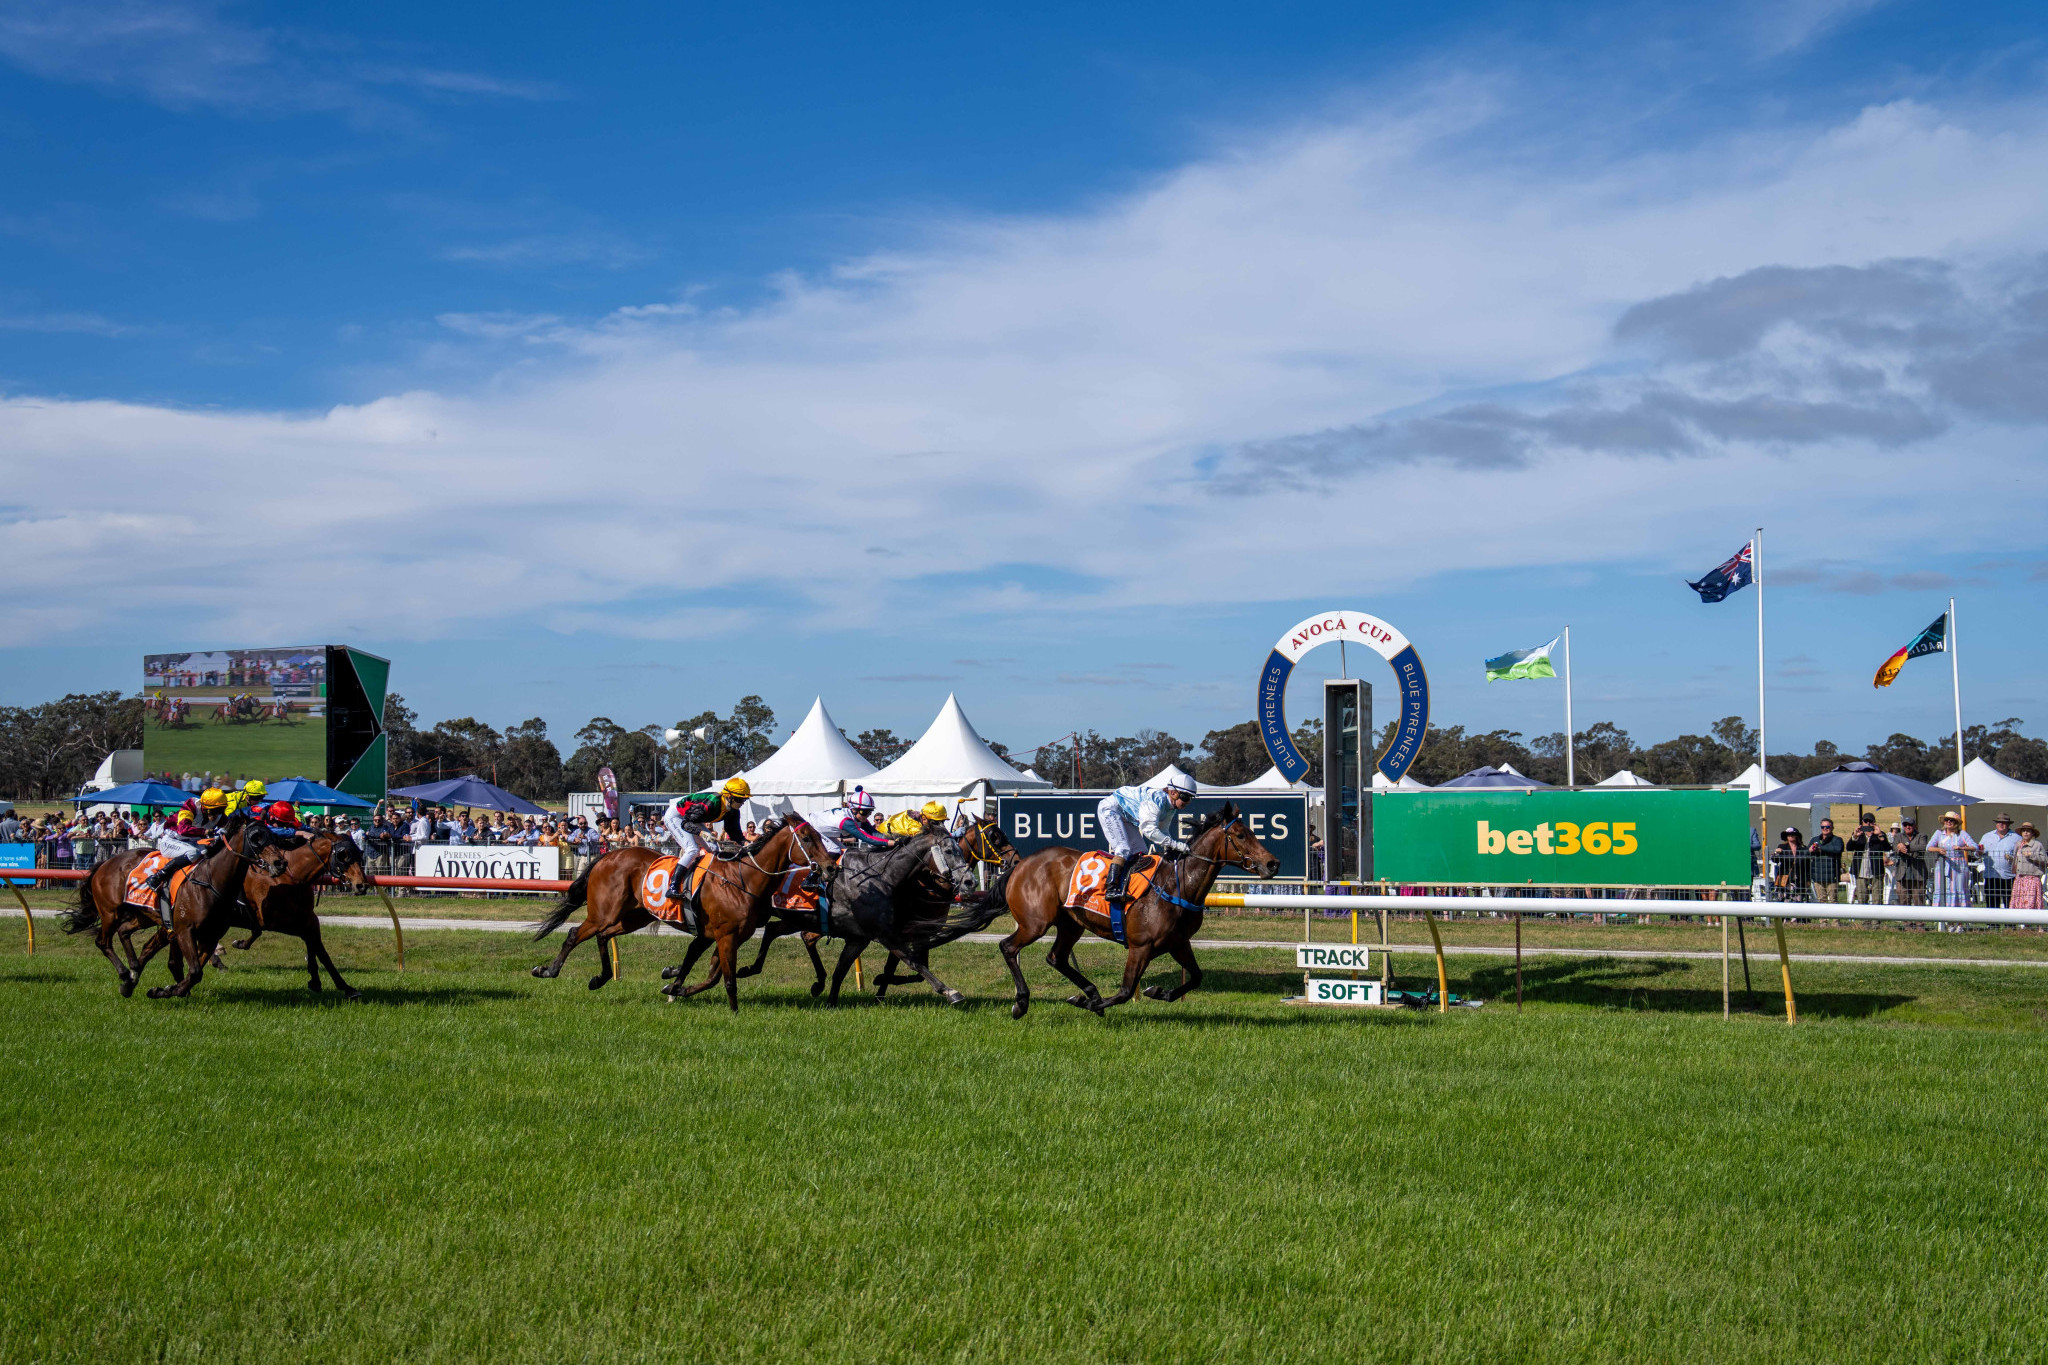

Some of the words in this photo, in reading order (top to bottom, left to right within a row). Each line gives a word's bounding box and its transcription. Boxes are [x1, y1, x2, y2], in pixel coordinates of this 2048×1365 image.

[1291, 618, 1347, 650] AVOCA
[1358, 621, 1392, 645] CUP
[1403, 663, 1420, 698] BLUE
[1265, 667, 1281, 734] PYRENEES
[1390, 702, 1420, 769] PYRENEES
[1269, 737, 1296, 769] BLUE
[1014, 813, 1096, 839] BLUE
[1477, 820, 1638, 855] bet365
[433, 855, 541, 880] ADVOCATE
[443, 850, 482, 859] PYRENEES
[131, 856, 160, 890] 3
[646, 869, 670, 907] 9
[1076, 857, 1106, 892] 8
[1300, 948, 1366, 967] TRACK
[1318, 983, 1373, 1001] SOFT
